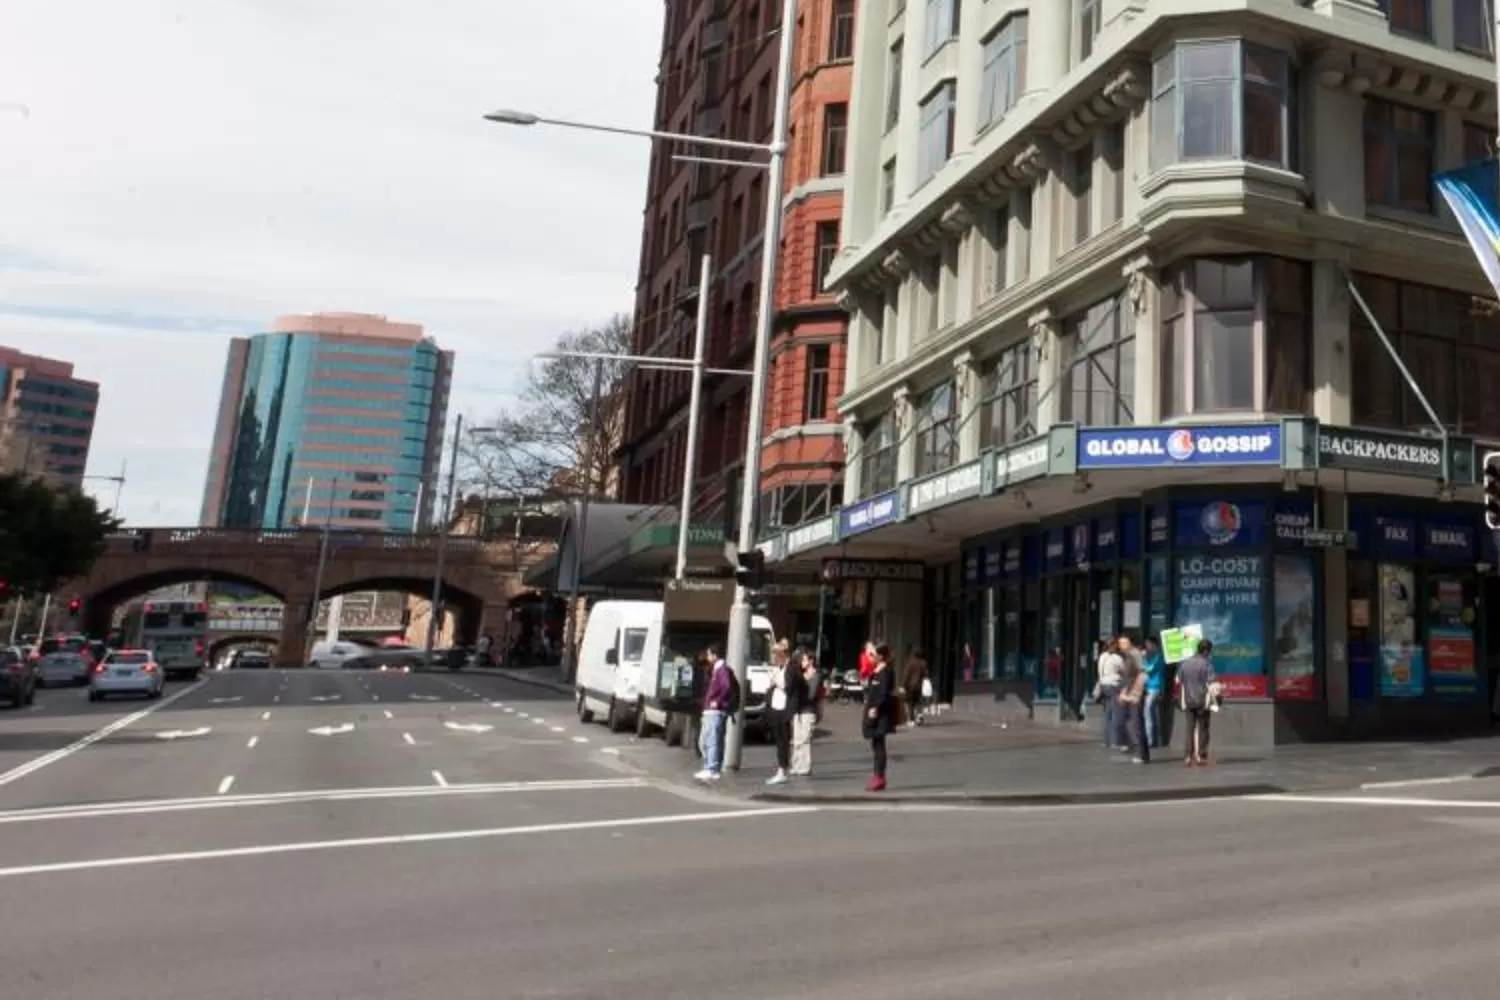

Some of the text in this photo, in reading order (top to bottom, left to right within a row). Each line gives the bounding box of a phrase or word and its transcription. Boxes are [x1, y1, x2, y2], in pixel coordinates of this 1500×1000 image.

[1086, 435, 1272, 456] GLOBAL GOSSIP
[1319, 435, 1440, 465] BACKPACKERS
[1275, 513, 1310, 526] CHEAP
[1384, 526, 1409, 541] FAX
[1430, 529, 1468, 547] EMAIL
[1180, 558, 1260, 575] LO-COST
[1180, 577, 1261, 590] CAMPERVAN
[1225, 591, 1260, 605] HIRE
